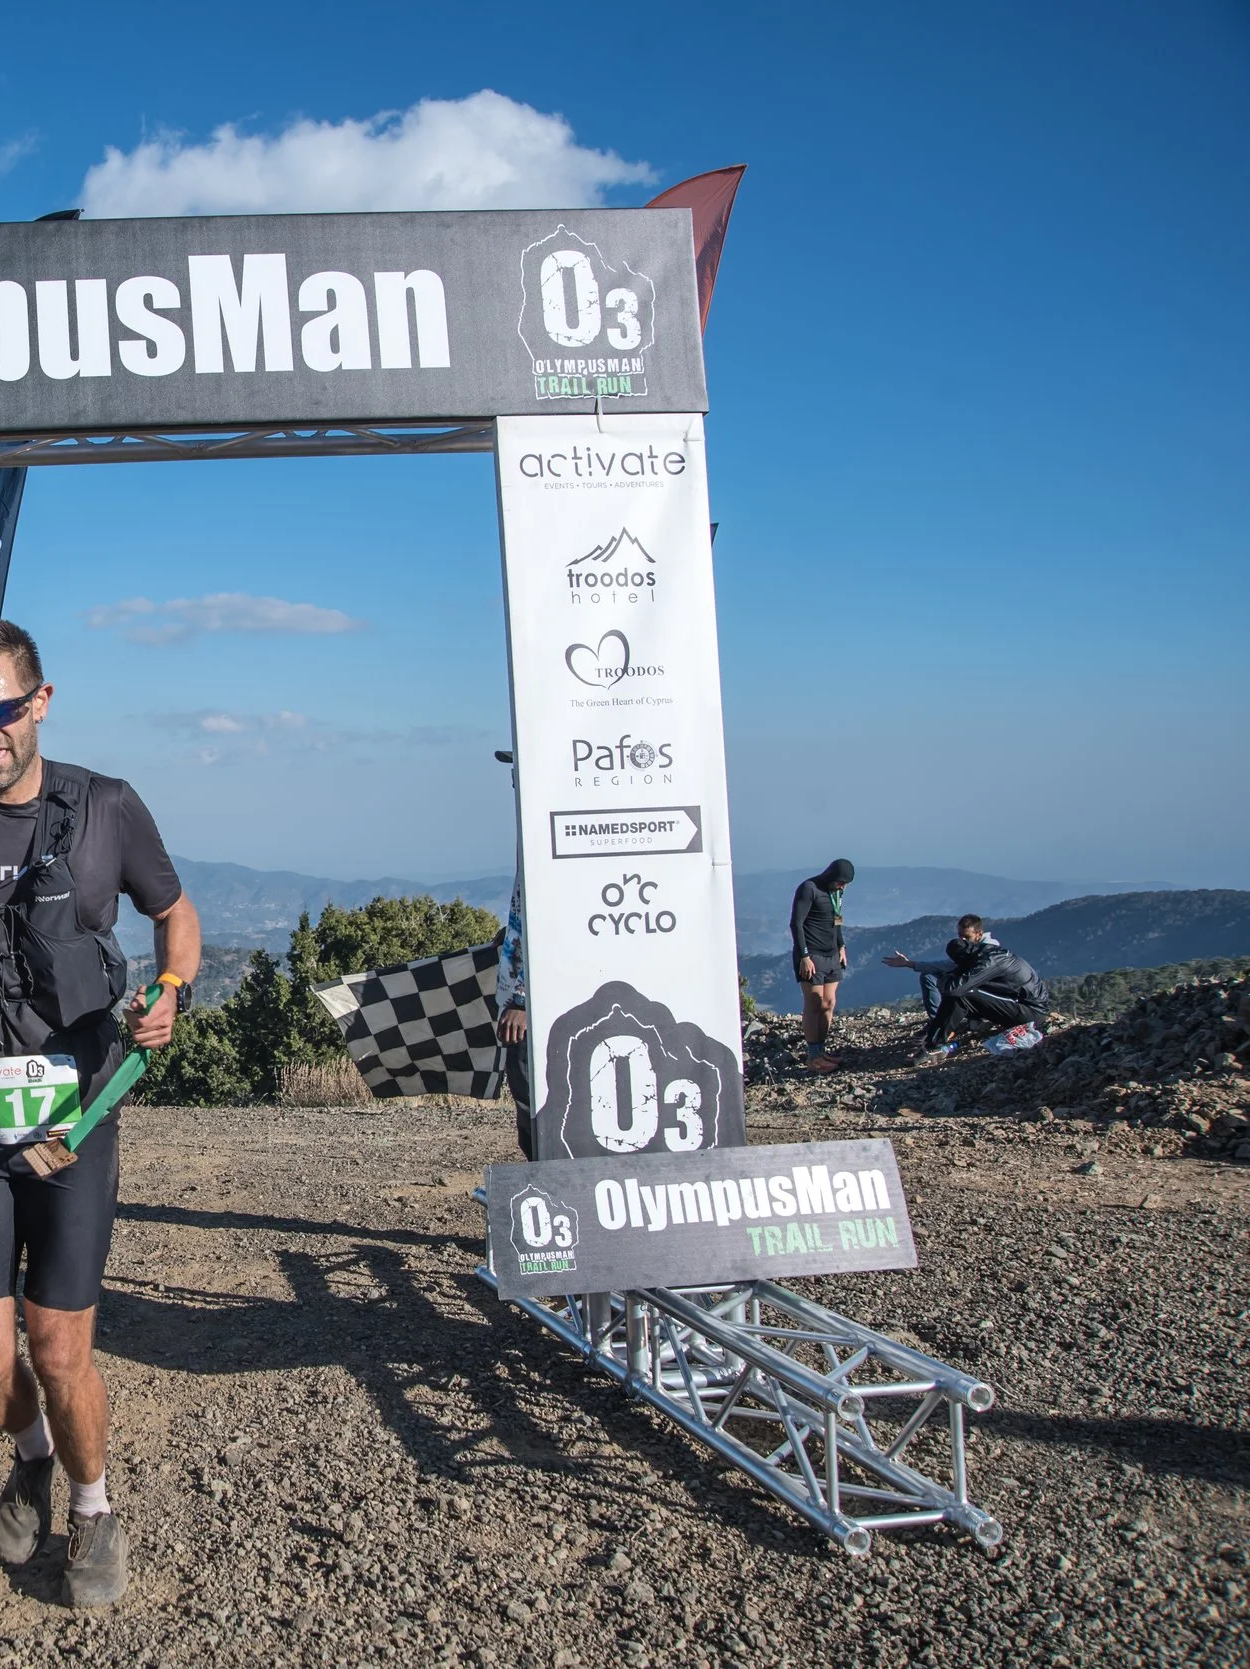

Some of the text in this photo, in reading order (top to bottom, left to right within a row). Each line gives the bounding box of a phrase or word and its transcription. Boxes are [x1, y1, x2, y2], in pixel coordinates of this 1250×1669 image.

[535, 357, 643, 374] OLYMPUSMAN
[537, 375, 632, 395] TRAIL RUN
[519, 444, 686, 478] activate
[544, 480, 665, 490] EVENTS TOURS ADVENTURES
[567, 567, 657, 588] troodos
[571, 588, 655, 604] hotel
[594, 665, 665, 679] TROODOS
[570, 695, 673, 708] The Green Heart of Cyprus
[574, 773, 673, 788] REGION
[589, 836, 654, 846] SUPERFOOD
[587, 910, 677, 936] CYCLO
[593, 1165, 892, 1233] OlympusMan
[747, 1216, 900, 1258] TRAIL RUN
[520, 1250, 574, 1262] OLYMPUSMAN
[521, 1259, 570, 1272] TRAIL RUN
